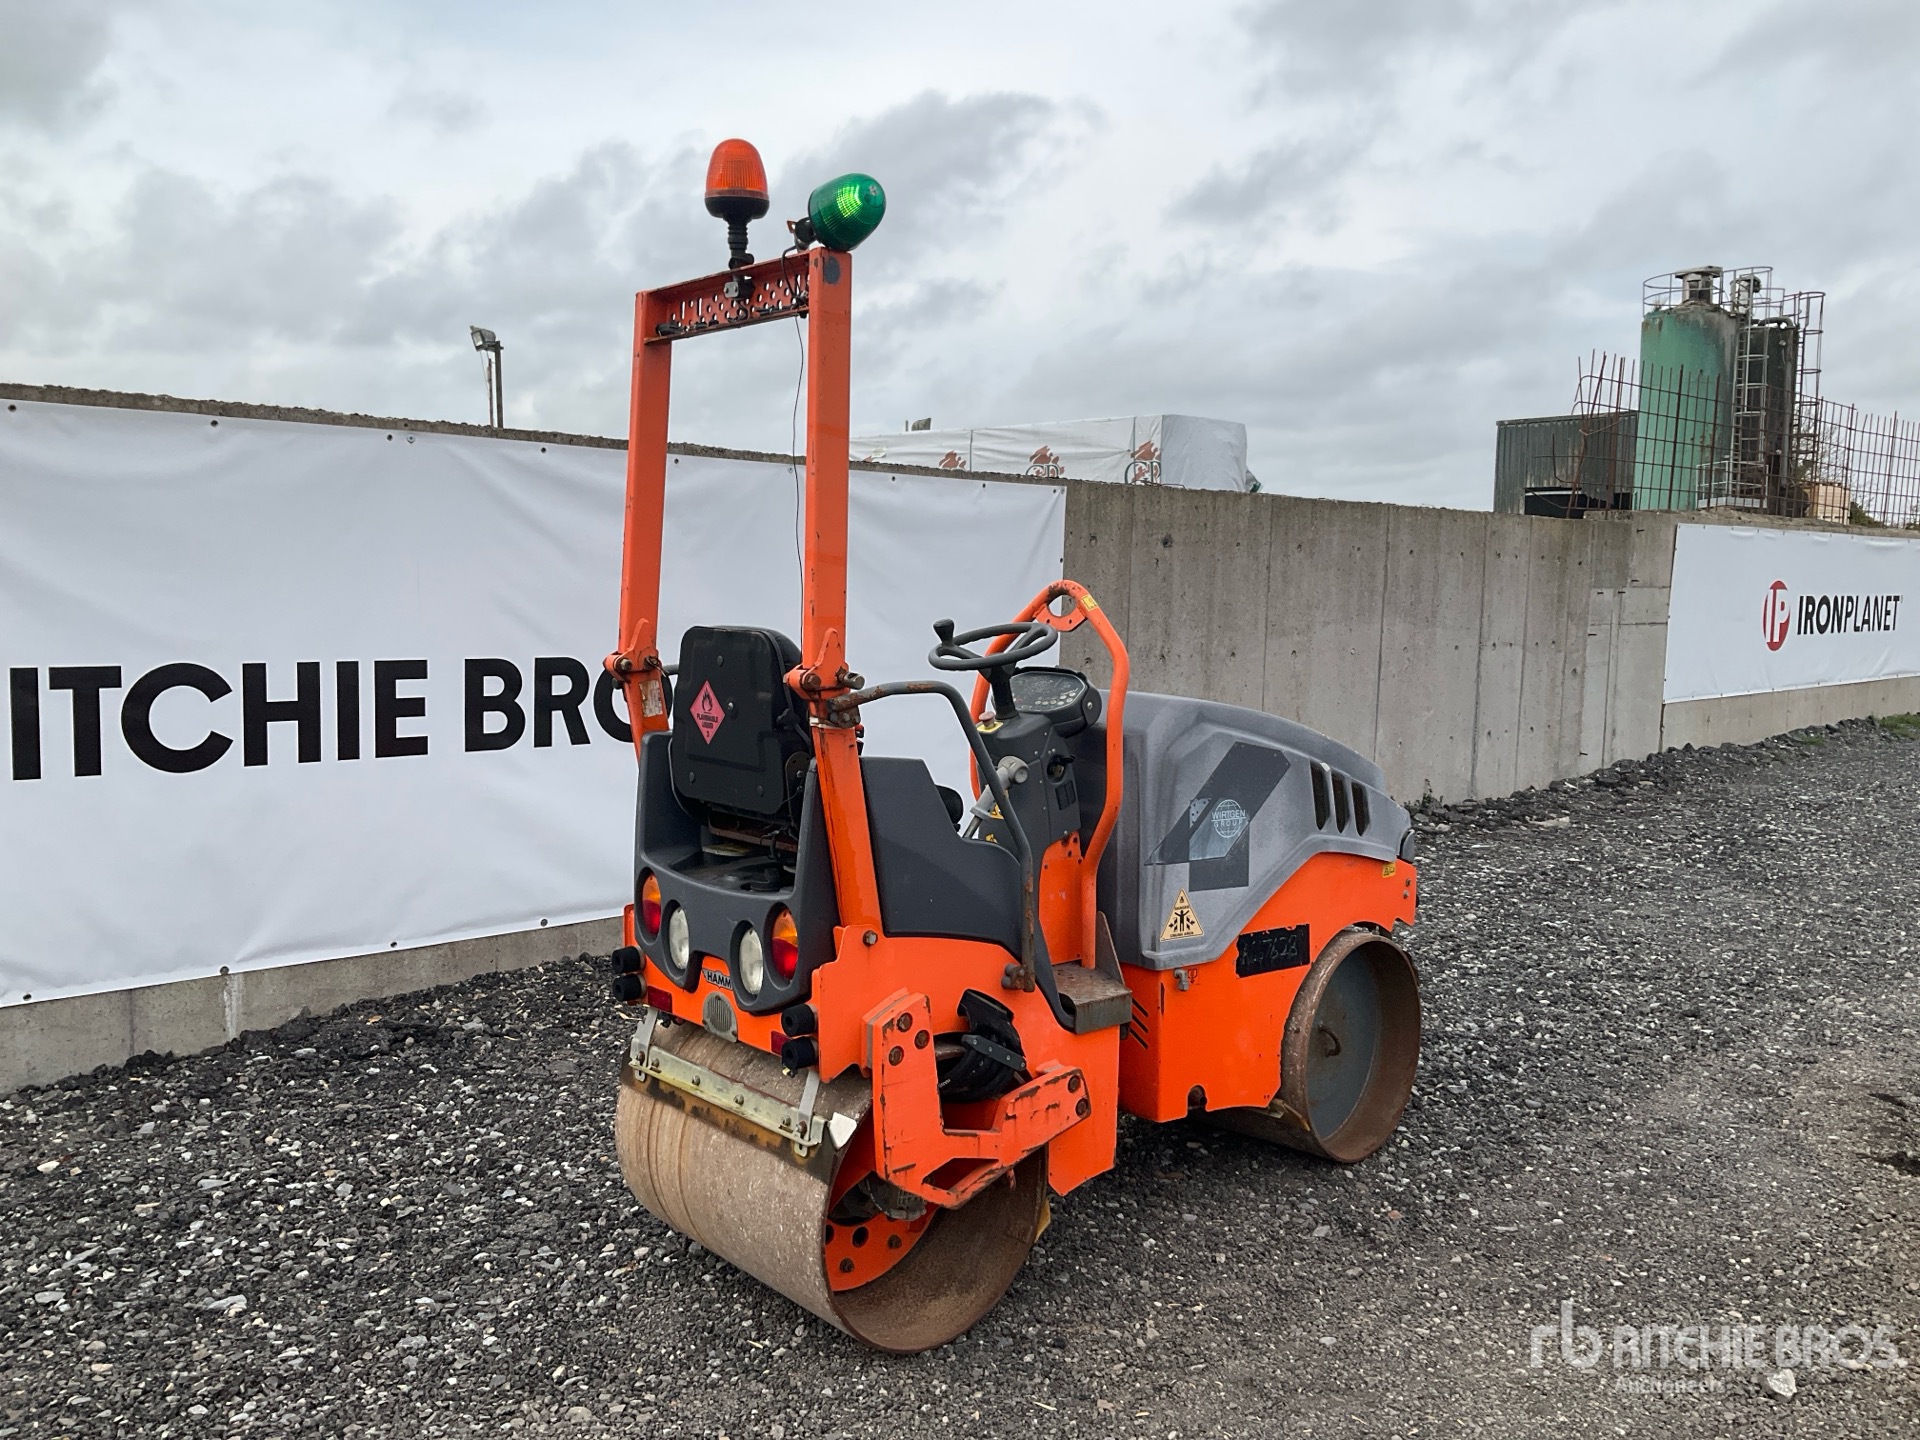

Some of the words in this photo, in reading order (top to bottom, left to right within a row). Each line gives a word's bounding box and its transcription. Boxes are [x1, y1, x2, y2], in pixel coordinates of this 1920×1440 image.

[1797, 594, 1900, 635] IRONPLANET
[10, 659, 428, 780] ITCHIE
[1211, 810, 1246, 820] WIRTGEN
[1213, 819, 1243, 828] GROUP
